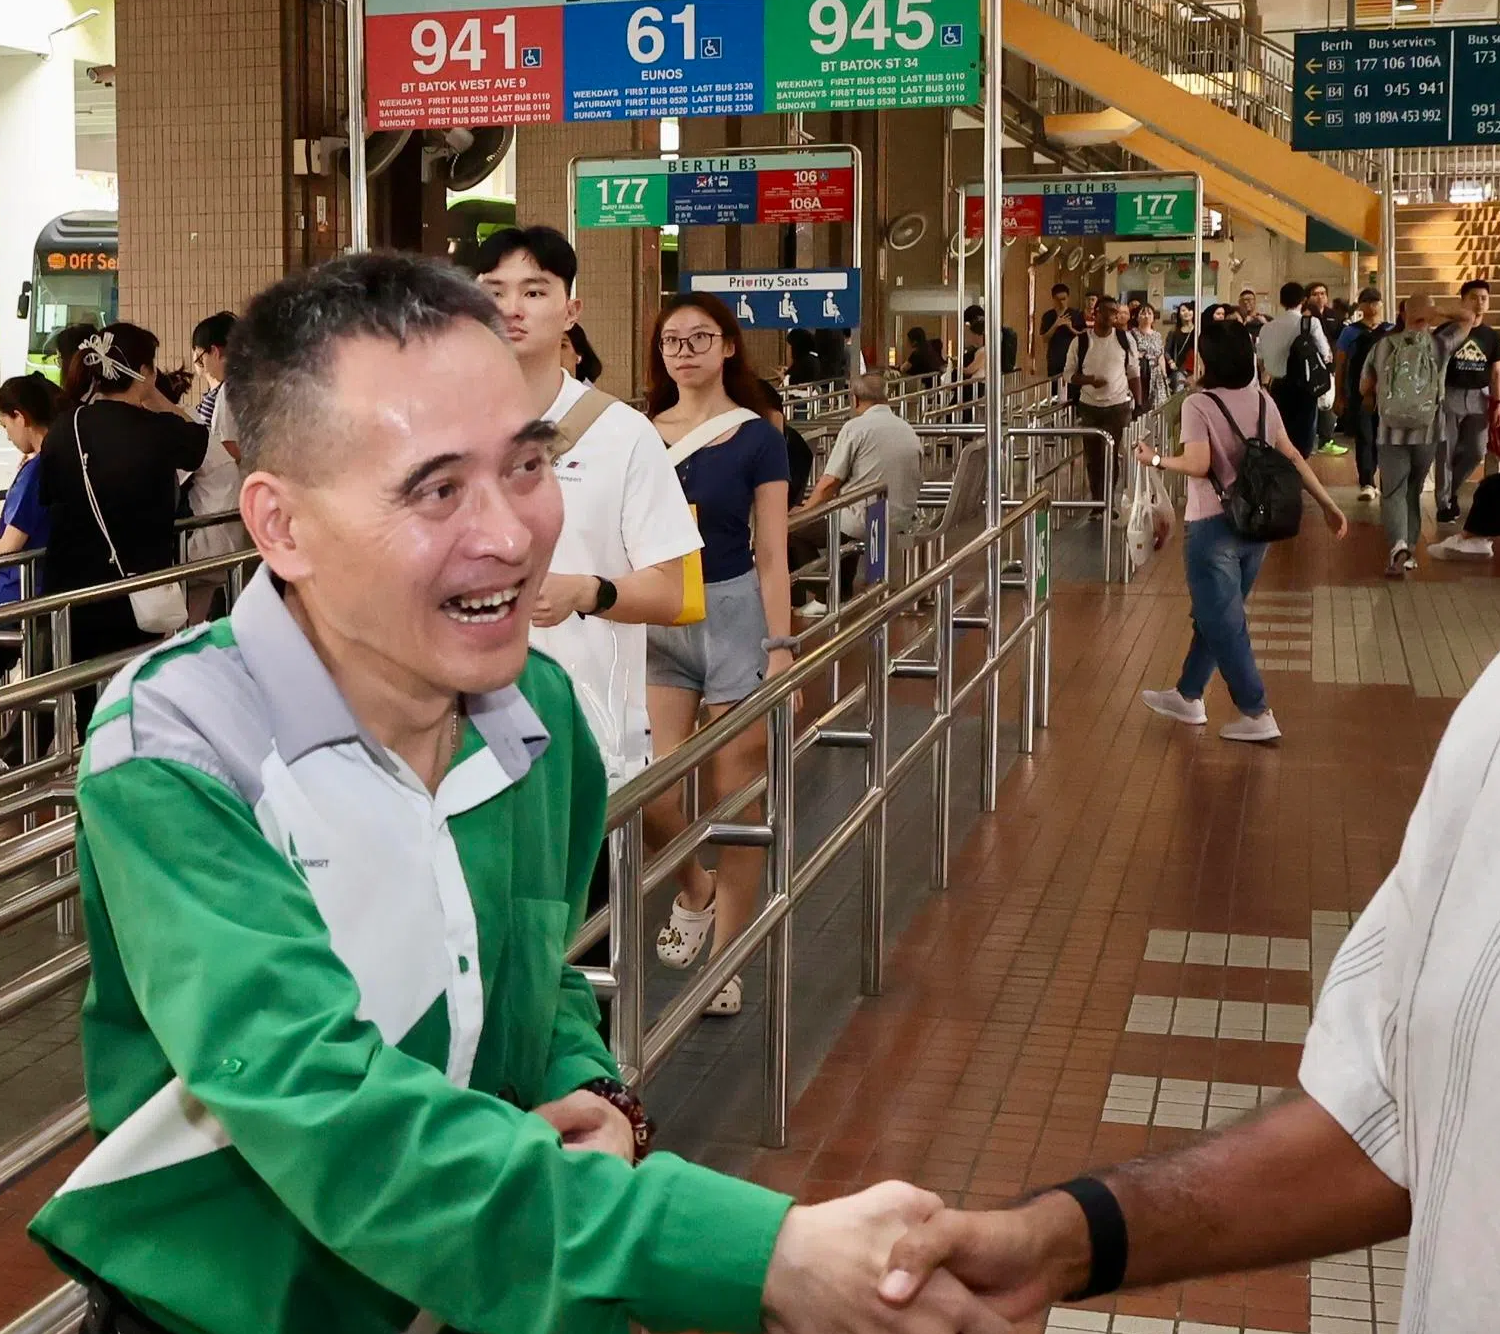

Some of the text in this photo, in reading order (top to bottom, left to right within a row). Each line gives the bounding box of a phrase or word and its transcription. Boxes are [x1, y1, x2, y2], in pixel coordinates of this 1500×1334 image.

[626, 4, 697, 63] 61
[1468, 35, 1488, 44] Bus
[411, 15, 517, 74] 941
[1322, 40, 1352, 51] Berth
[1369, 36, 1436, 49] Bus services
[1329, 56, 1441, 71] B3 177 106 106A
[1473, 51, 1496, 63] 173
[821, 58, 918, 72] BT BATOK ST 34
[642, 69, 683, 80] EUNOS
[402, 78, 526, 92] BT BATOK WEST AVE 9
[573, 89, 618, 98] WEEKDAYS
[625, 87, 648, 96] FIRST
[670, 86, 687, 94] 0520
[692, 85, 713, 93] LAST
[715, 84, 732, 92] BUS
[735, 83, 753, 91] 2330
[1329, 82, 1444, 97] B4 61 945 941
[1472, 103, 1495, 116] 991
[1328, 110, 1440, 124] B5 189 189A 453 992
[668, 158, 756, 173] BERTH B3
[794, 171, 816, 183] 106
[597, 179, 648, 203] 177
[1044, 183, 1116, 194] BERTH B3
[790, 198, 821, 209] 106A
[1133, 195, 1177, 215] 177
[70, 253, 119, 270] Off Se
[777, 276, 808, 287] Seats
